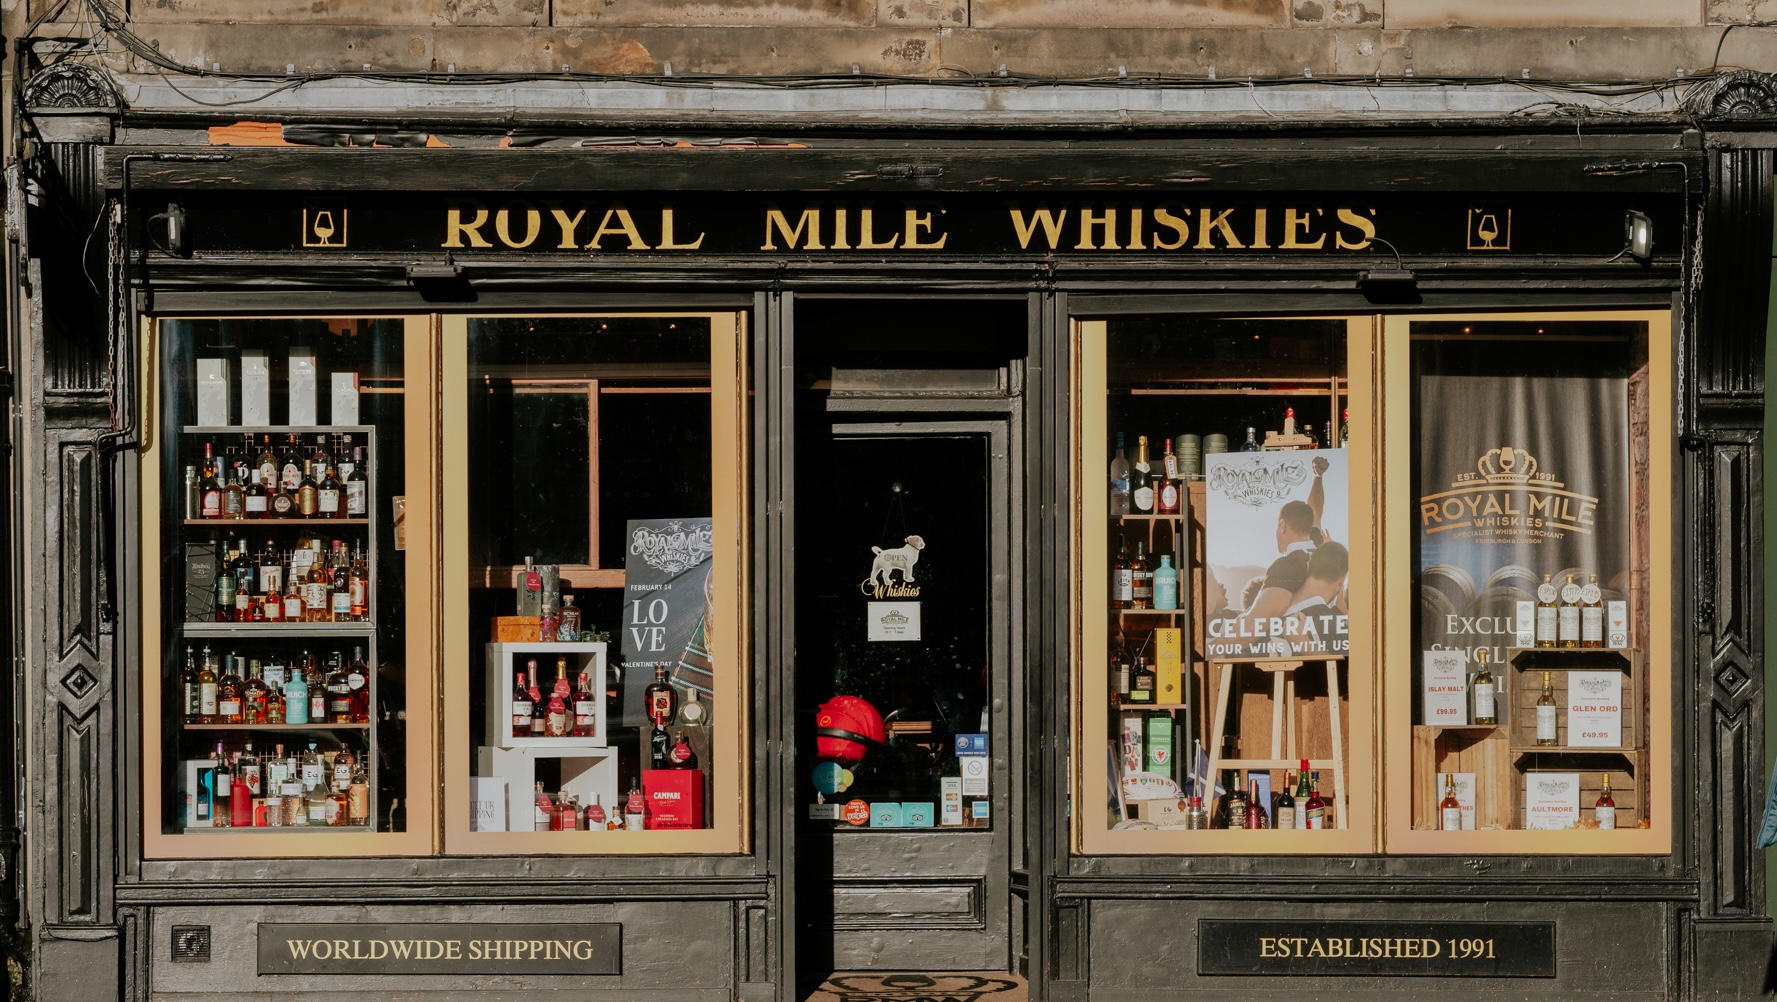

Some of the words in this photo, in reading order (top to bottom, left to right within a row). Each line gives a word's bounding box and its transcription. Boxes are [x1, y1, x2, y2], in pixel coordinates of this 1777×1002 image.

[441, 204, 705, 251] ROYAL
[760, 204, 948, 251] MILE
[1008, 204, 1377, 251] WHISKIES
[1457, 472, 1478, 482] EST.
[1536, 472, 1556, 482] 1991
[1242, 487, 1274, 499] WHISKIES
[1420, 494, 1520, 526] ROYAL
[1528, 494, 1598, 526] MILE
[1474, 516, 1543, 528] WHISKIES
[1453, 529, 1494, 540] SPECIALIST
[1524, 530, 1564, 540] MERCHANT
[660, 552, 690, 564] WHISKIES
[884, 553, 908, 562] OPEN
[861, 578, 920, 599] Whiskies
[630, 598, 668, 624] LO
[1208, 614, 1348, 638] CELEBRATE
[630, 626, 666, 652] VE
[1208, 644, 1242, 655] YOUR
[1249, 642, 1285, 654] WINS
[1292, 641, 1326, 652] WITH
[1333, 640, 1349, 650] US
[485, 801, 494, 810] UK
[287, 939, 462, 960] WORLDWIDE
[468, 939, 594, 960] SHIPPING
[1260, 938, 1440, 958] ESTABLISHED
[1448, 938, 1496, 959] 1991
